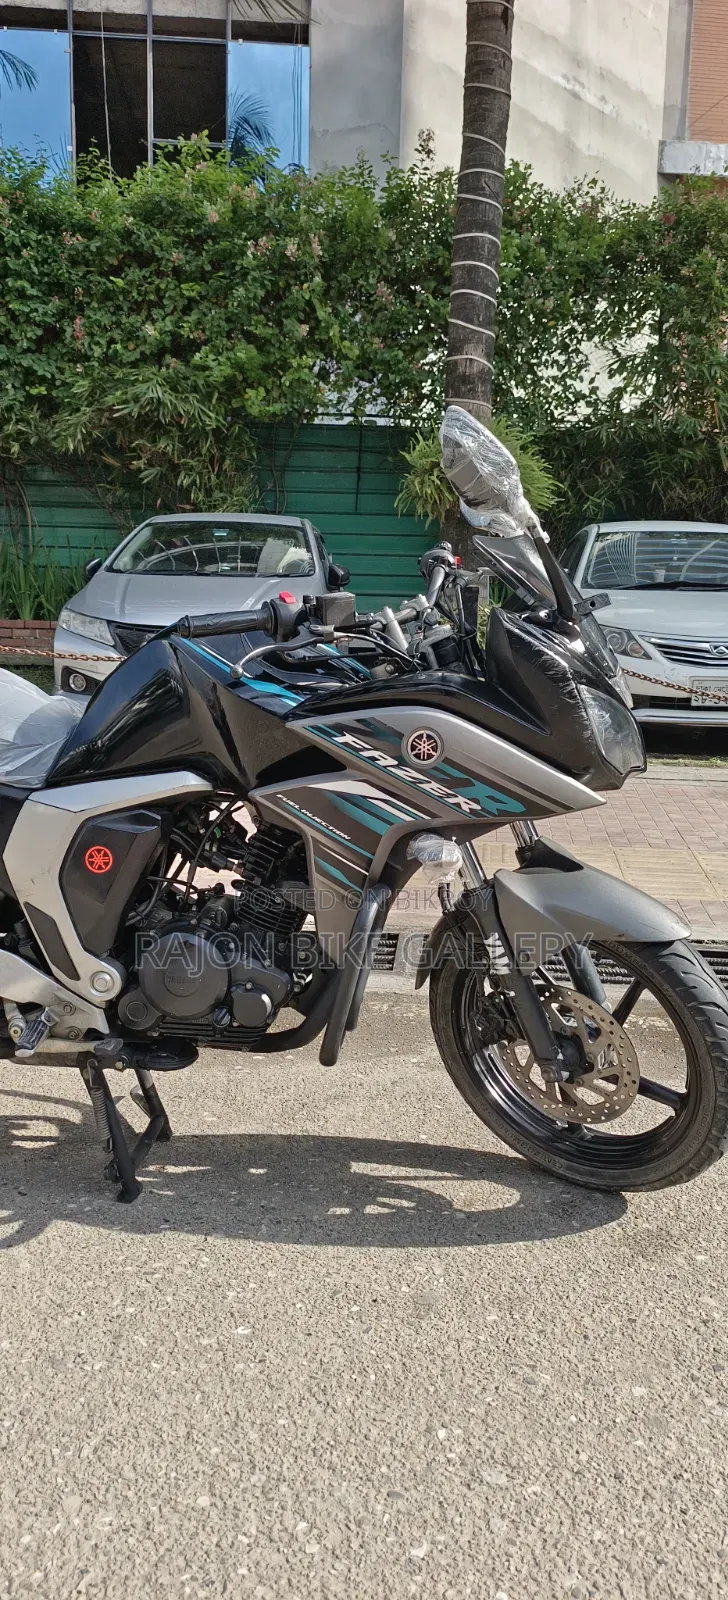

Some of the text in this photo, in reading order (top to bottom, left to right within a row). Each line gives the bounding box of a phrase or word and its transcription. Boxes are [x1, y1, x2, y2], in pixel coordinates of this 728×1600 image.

[331, 731, 482, 814] FAZER
[276, 794, 352, 840] FUEL INJECTION
